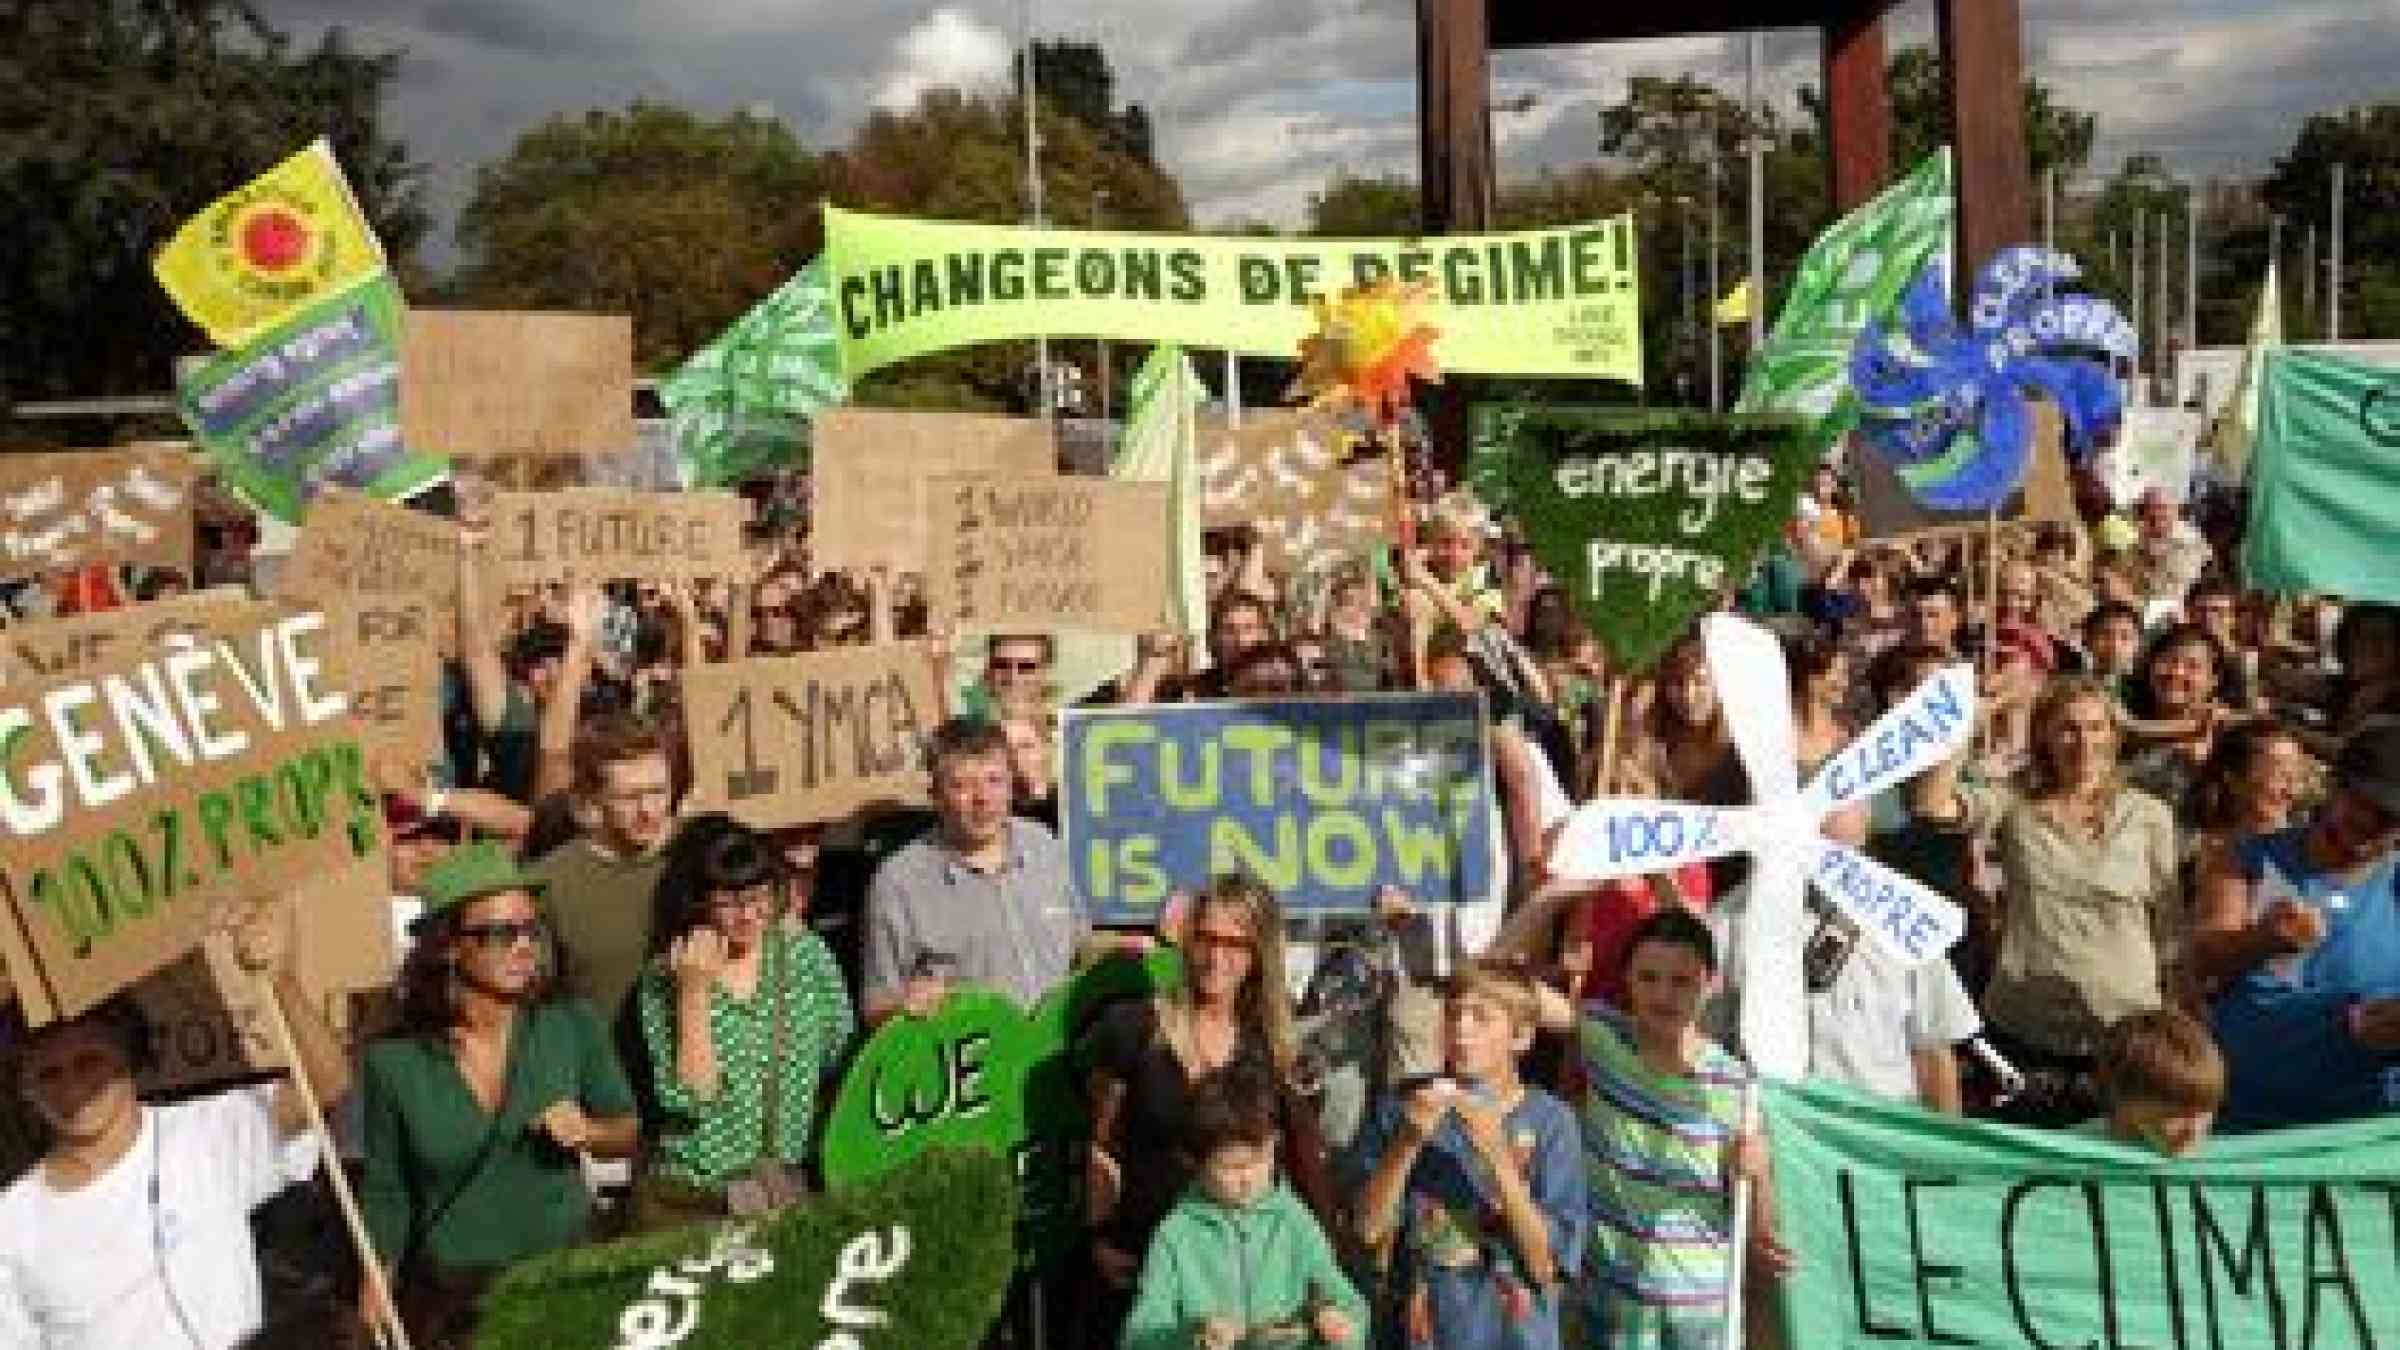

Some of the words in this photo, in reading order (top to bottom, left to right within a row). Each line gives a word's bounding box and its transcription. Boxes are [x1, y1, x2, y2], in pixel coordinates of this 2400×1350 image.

[841, 247, 1206, 340] CHANGEONS
[1240, 258, 1320, 305] DE
[512, 516, 546, 560] 1
[556, 509, 708, 560] FUTURE
[0, 612, 348, 834] GENÈVE
[718, 684, 778, 800] 1
[772, 666, 920, 788] YMCA
[1825, 678, 1964, 800] CLEAN
[1084, 832, 1168, 903] IS
[1207, 778, 1480, 892] NOW
[1820, 850, 1940, 957] PROPRE
[870, 1033, 991, 1134] WE
[1836, 1168, 1984, 1346] LE
